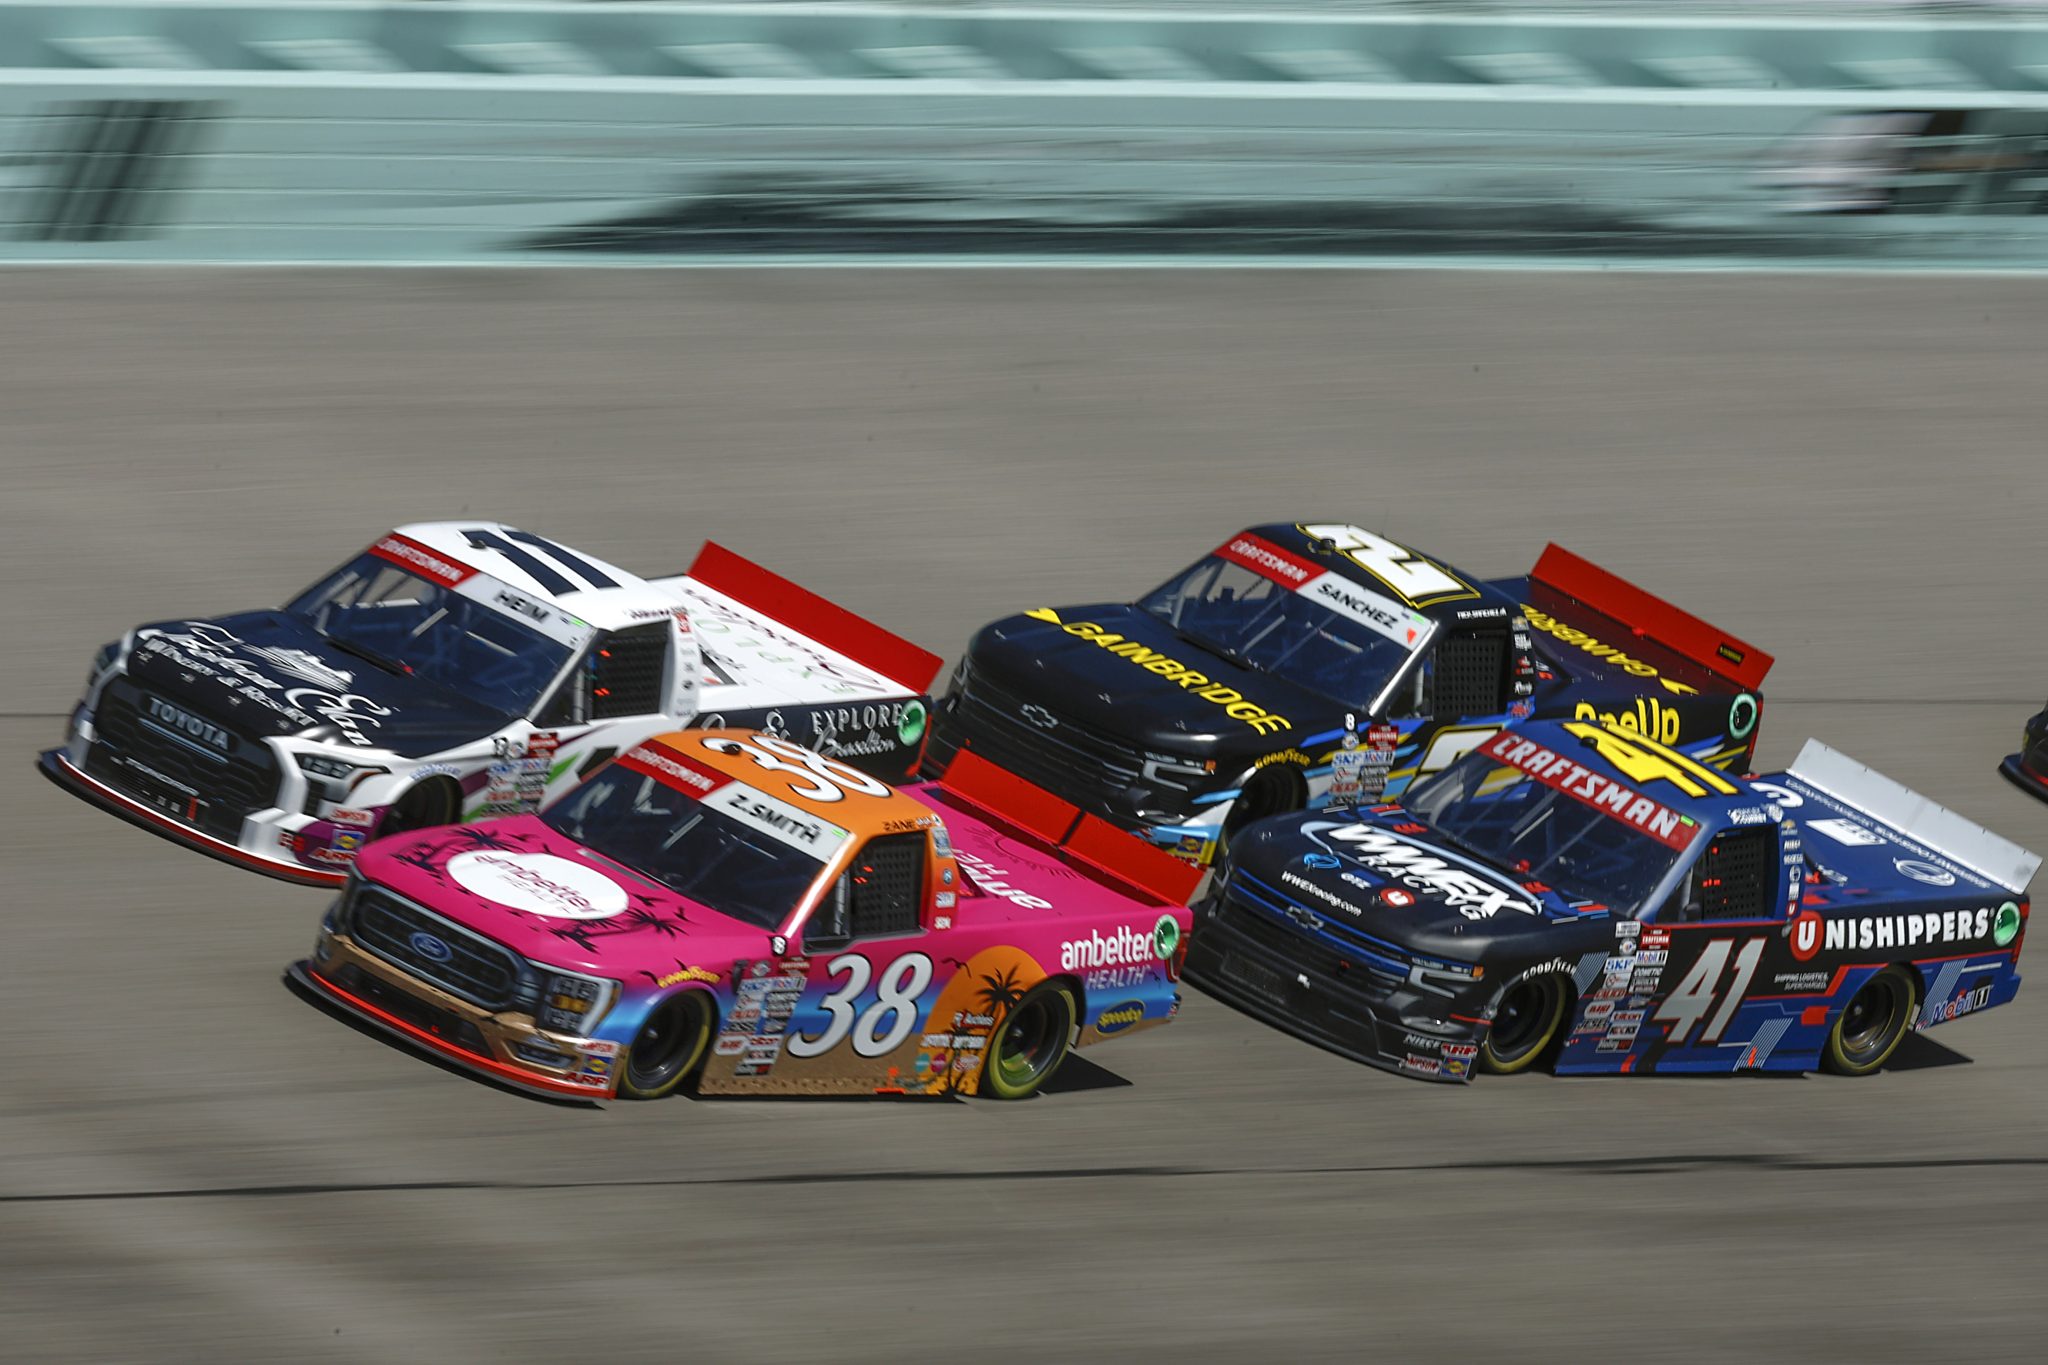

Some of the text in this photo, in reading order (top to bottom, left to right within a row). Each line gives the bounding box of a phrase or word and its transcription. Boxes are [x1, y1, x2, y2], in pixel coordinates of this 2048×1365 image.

[1229, 539, 1308, 581] CRAFTSMAN
[495, 589, 551, 625] HEIM
[1316, 583, 1400, 631] SANCHEZ
[1065, 621, 1292, 736] GAINBRIDGE
[150, 697, 230, 751] TOYOTA
[700, 732, 893, 803] 38
[1562, 722, 1740, 799] 41
[1492, 734, 1682, 839] CRAFTSMAN
[727, 793, 821, 845] Z.SMITH
[1796, 908, 1989, 951] UNISHIPPERS
[1084, 966, 1147, 991] HEALTH
[1521, 956, 1578, 983] GOODYEAR
[1606, 957, 1634, 970] SKF
[785, 951, 934, 1059] 38
[1651, 936, 1768, 1045] 41
[1931, 992, 1972, 1021] Mobil
